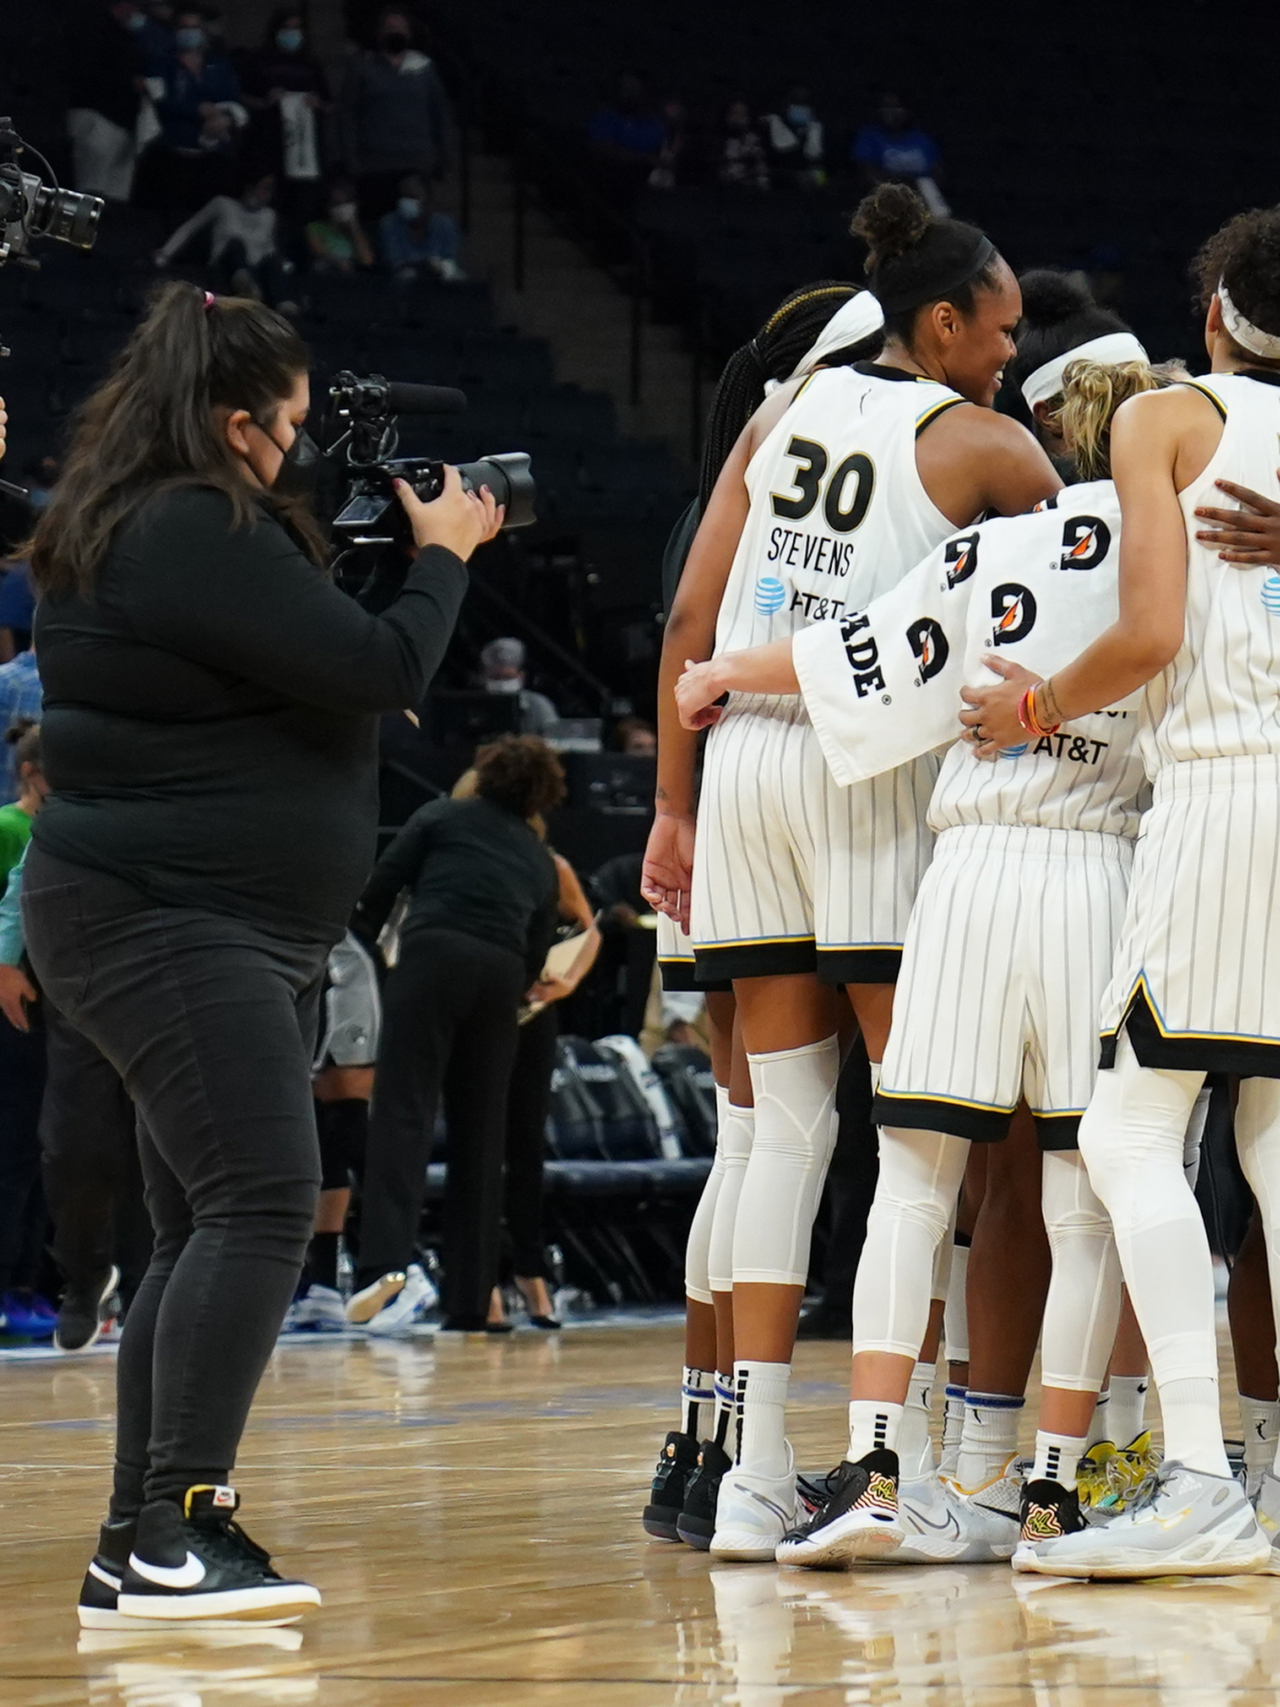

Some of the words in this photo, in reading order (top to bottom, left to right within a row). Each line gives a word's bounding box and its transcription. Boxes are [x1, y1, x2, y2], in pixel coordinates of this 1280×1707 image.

[770, 435, 877, 535] 30
[768, 527, 854, 577] STEVENS
[789, 589, 845, 620] AT&T
[1033, 733, 1109, 765] AT&T
